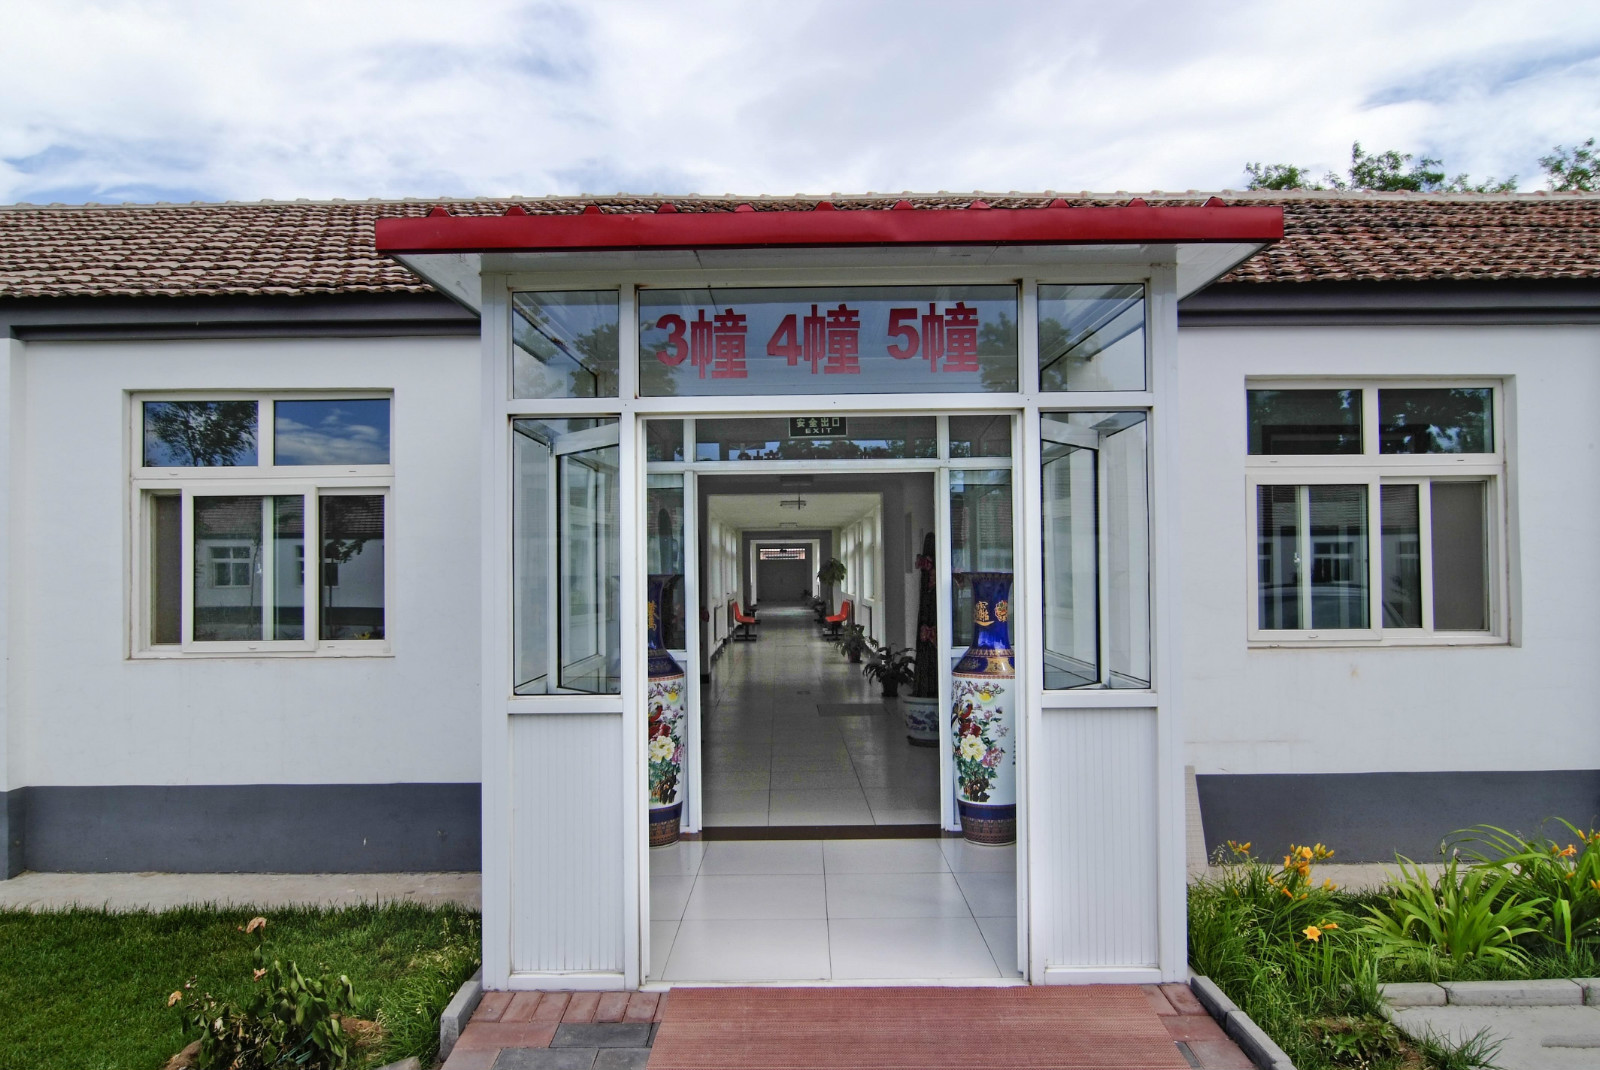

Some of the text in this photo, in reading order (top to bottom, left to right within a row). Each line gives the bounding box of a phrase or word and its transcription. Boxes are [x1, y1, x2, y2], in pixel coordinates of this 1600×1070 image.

[655, 301, 980, 380] 3幢 4幢 5幢
[796, 417, 840, 428] 安全出口
